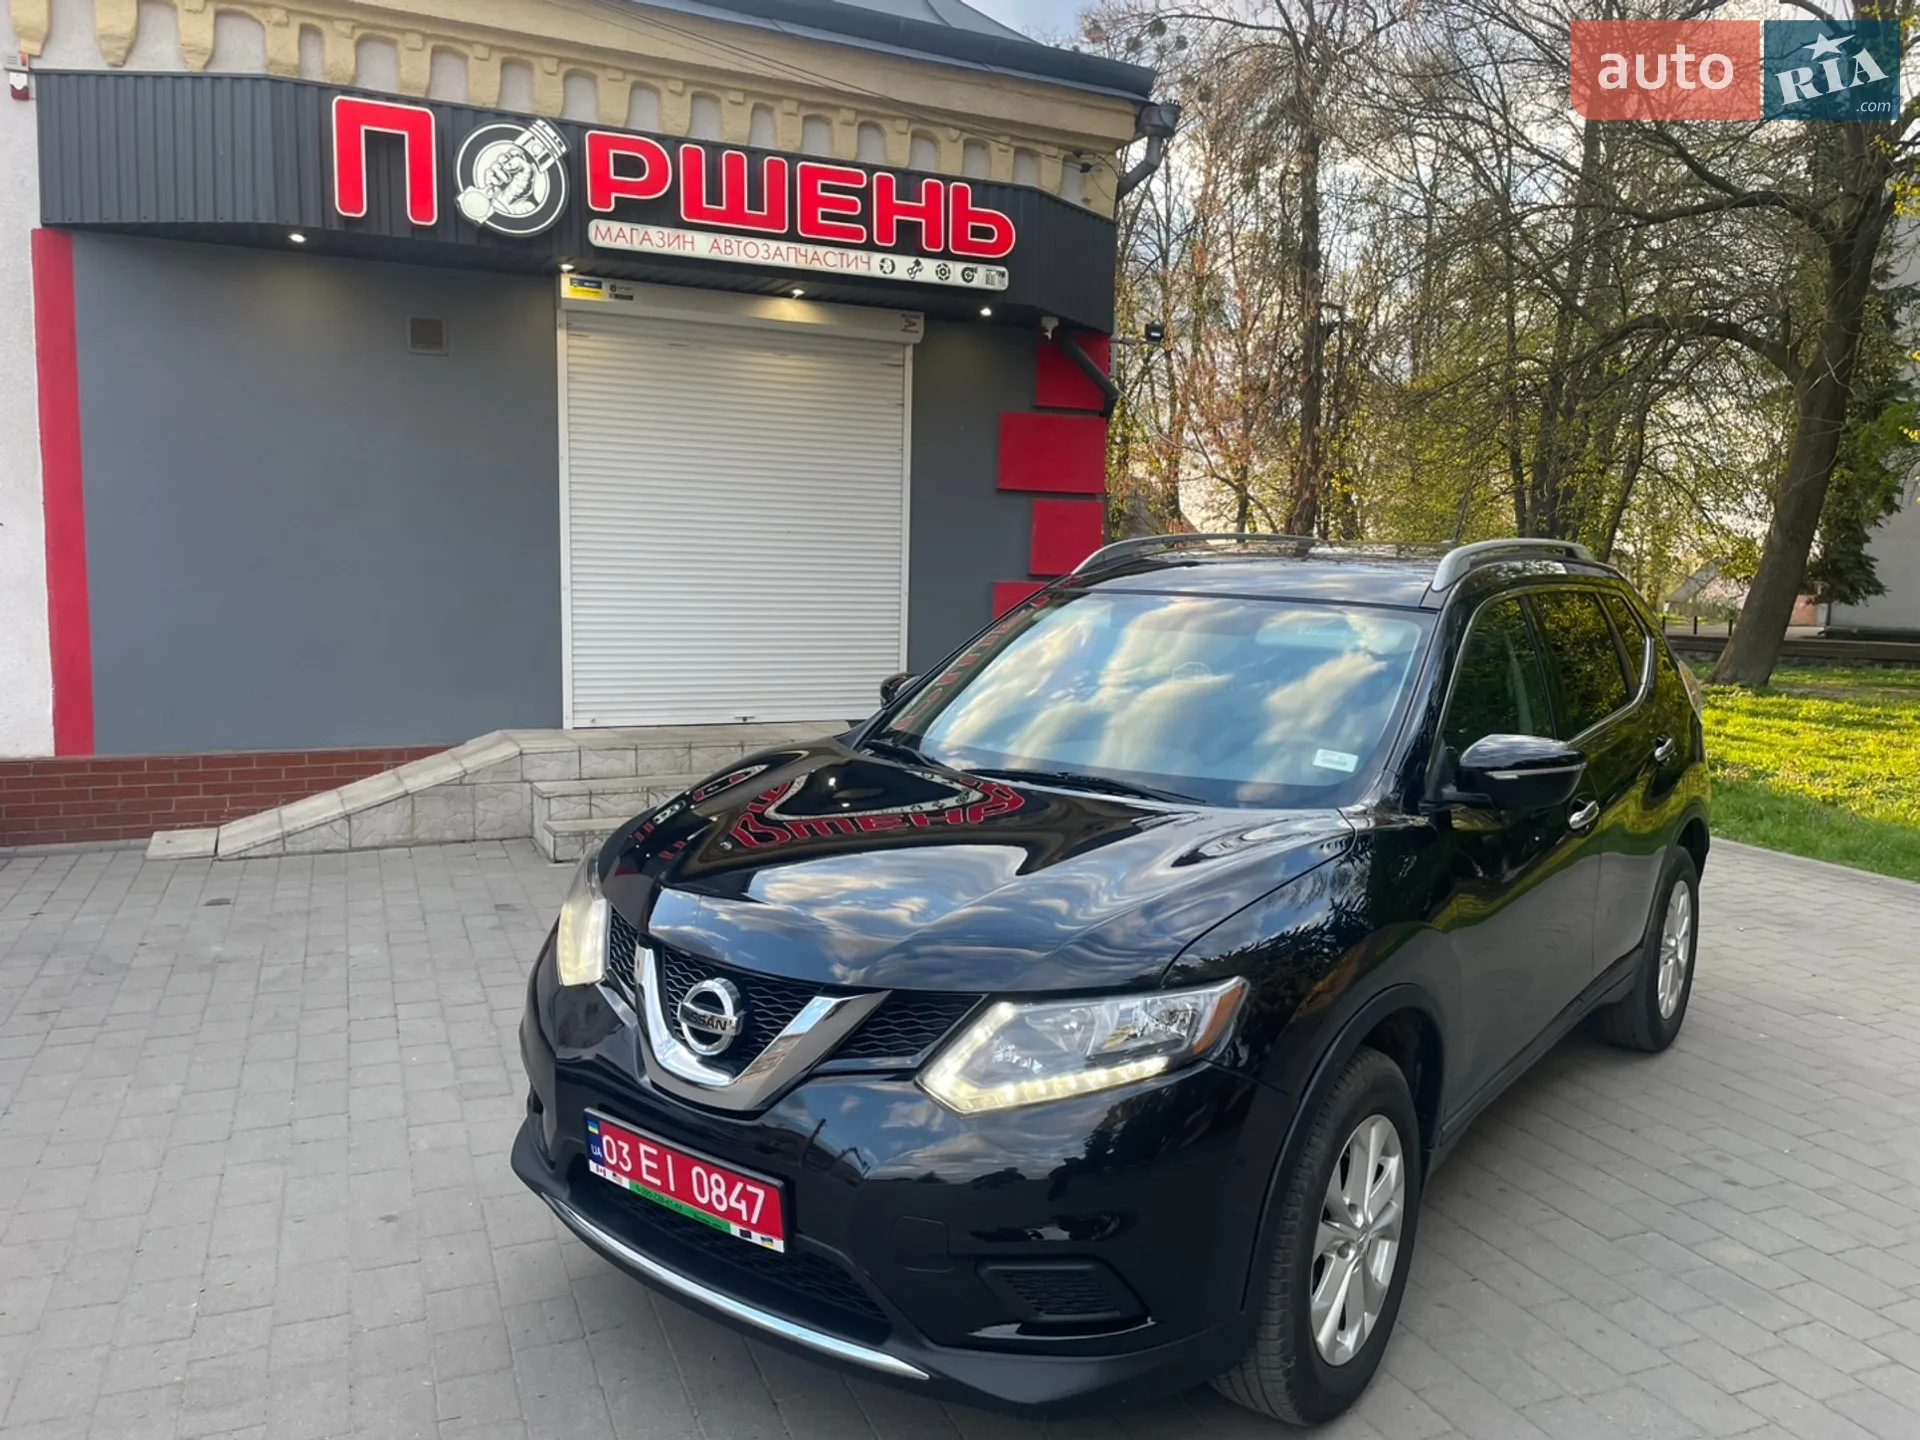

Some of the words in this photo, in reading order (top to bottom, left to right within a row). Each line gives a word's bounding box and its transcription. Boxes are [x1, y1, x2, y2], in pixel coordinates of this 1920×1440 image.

[594, 224, 695, 252] МАГАЗИН
[682, 1007, 729, 1031] NISSAN
[590, 1143, 603, 1158] UA
[602, 1134, 632, 1172] 03
[690, 1165, 766, 1225] 0847
